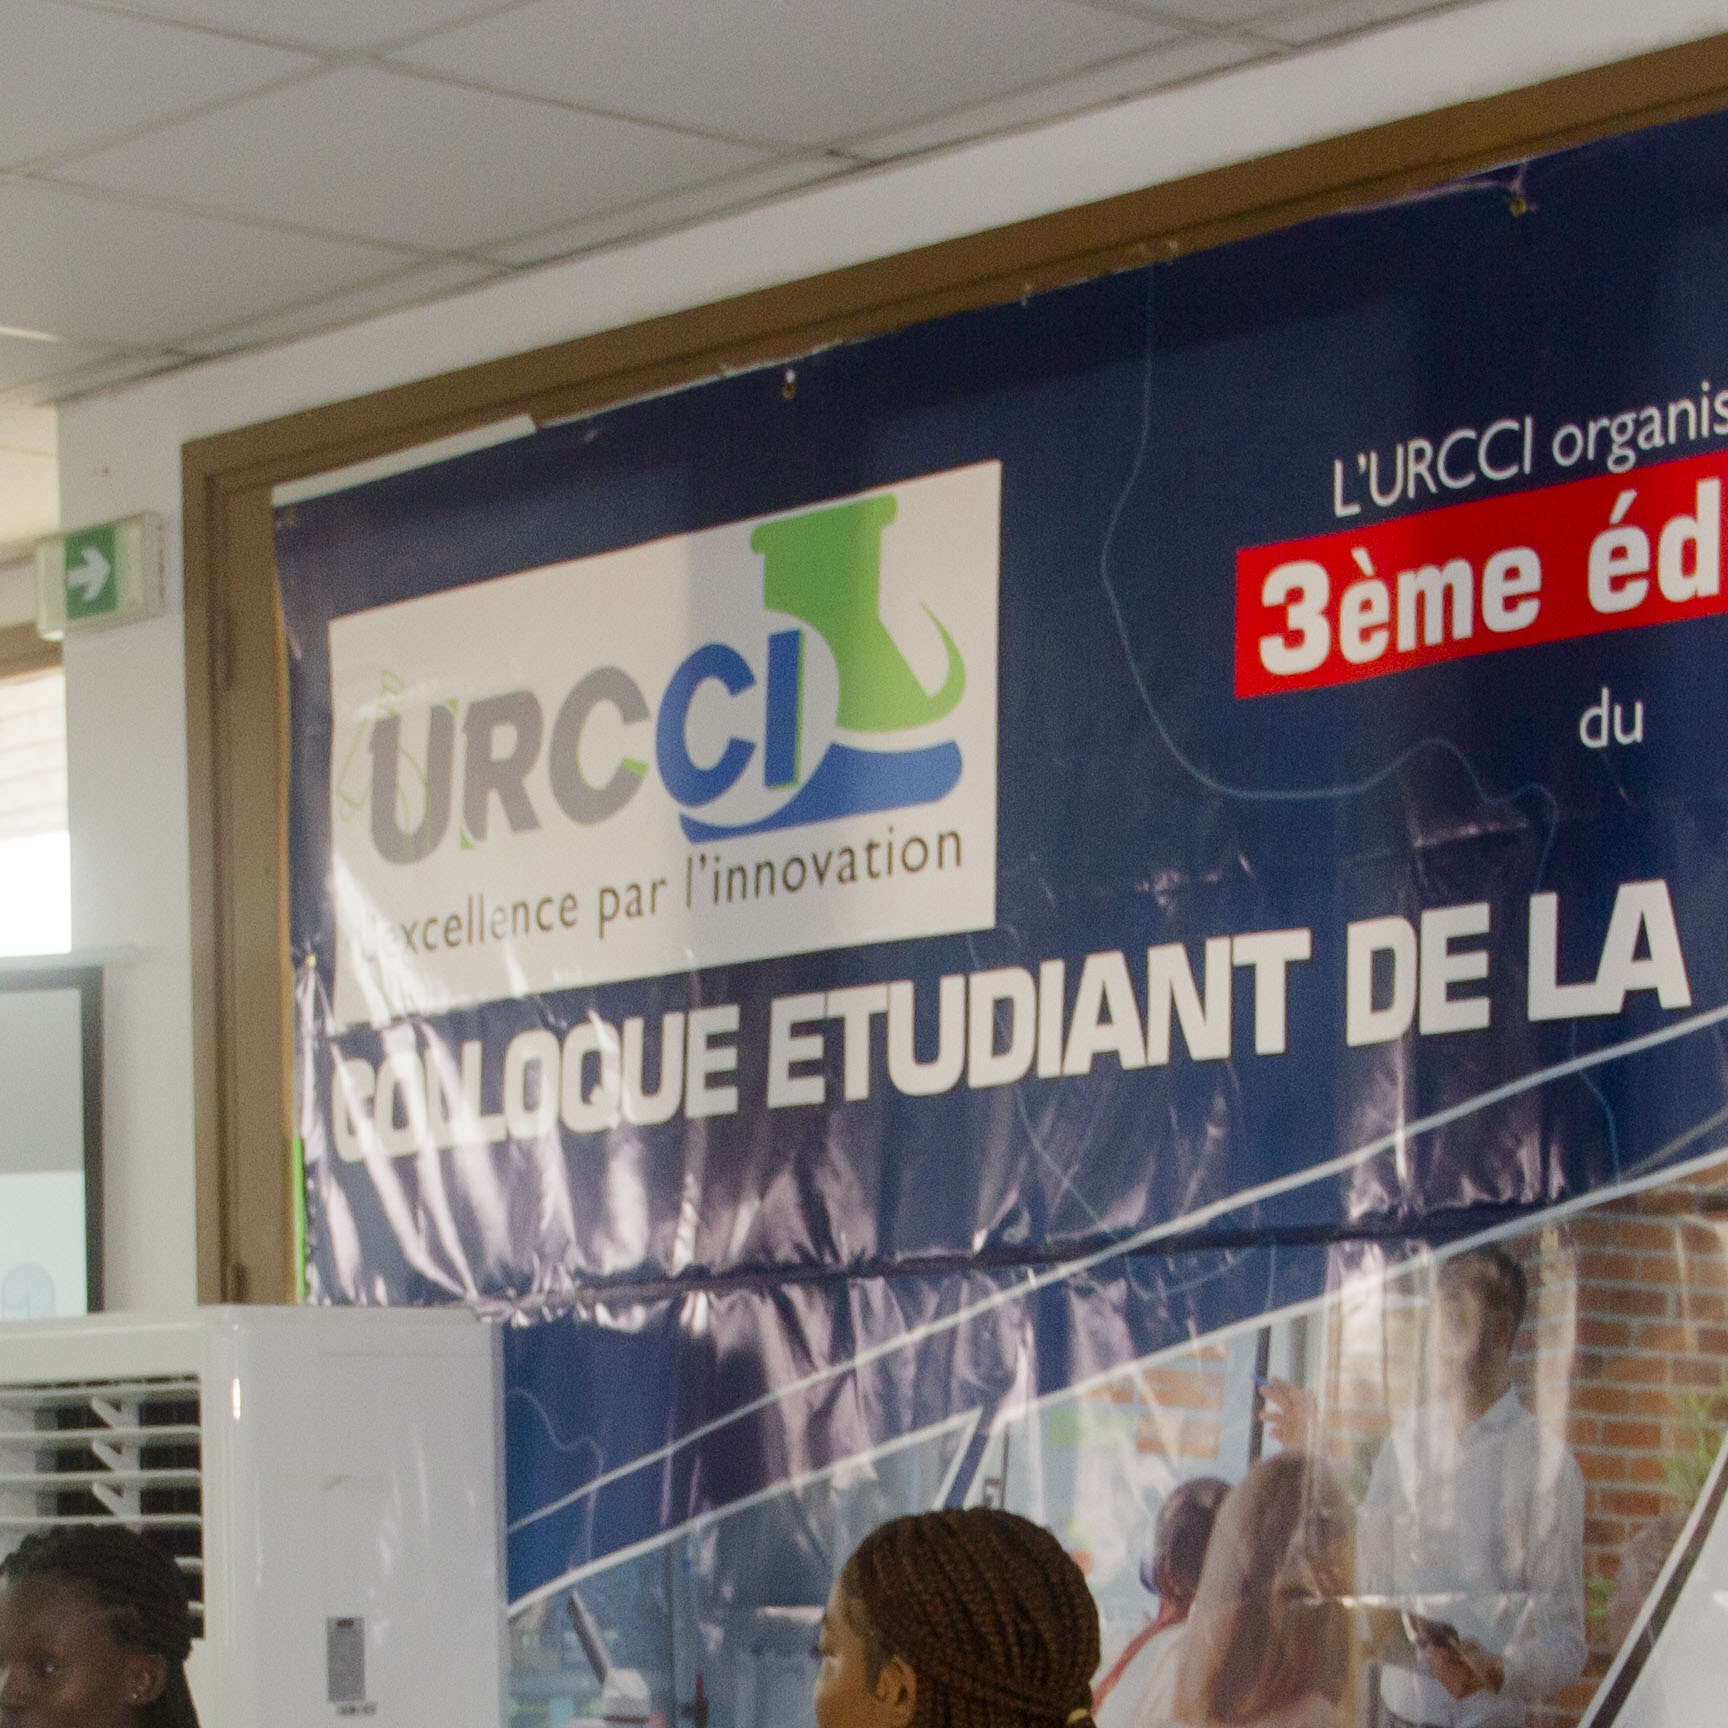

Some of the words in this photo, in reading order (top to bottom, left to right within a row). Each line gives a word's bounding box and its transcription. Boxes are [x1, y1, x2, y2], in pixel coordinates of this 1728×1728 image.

[1332, 419, 1533, 517] L'URCCI
[1259, 547, 1541, 677] 3ème
[367, 628, 805, 866] URCCI
[1580, 687, 1644, 749] du
[598, 878, 668, 938] par
[685, 826, 963, 910] l'innovation
[332, 1004, 740, 1163] COLLOQUE
[767, 928, 1311, 1109] ETUDIANT
[1347, 903, 1490, 1048] DE
[1528, 880, 1692, 1021] LA
